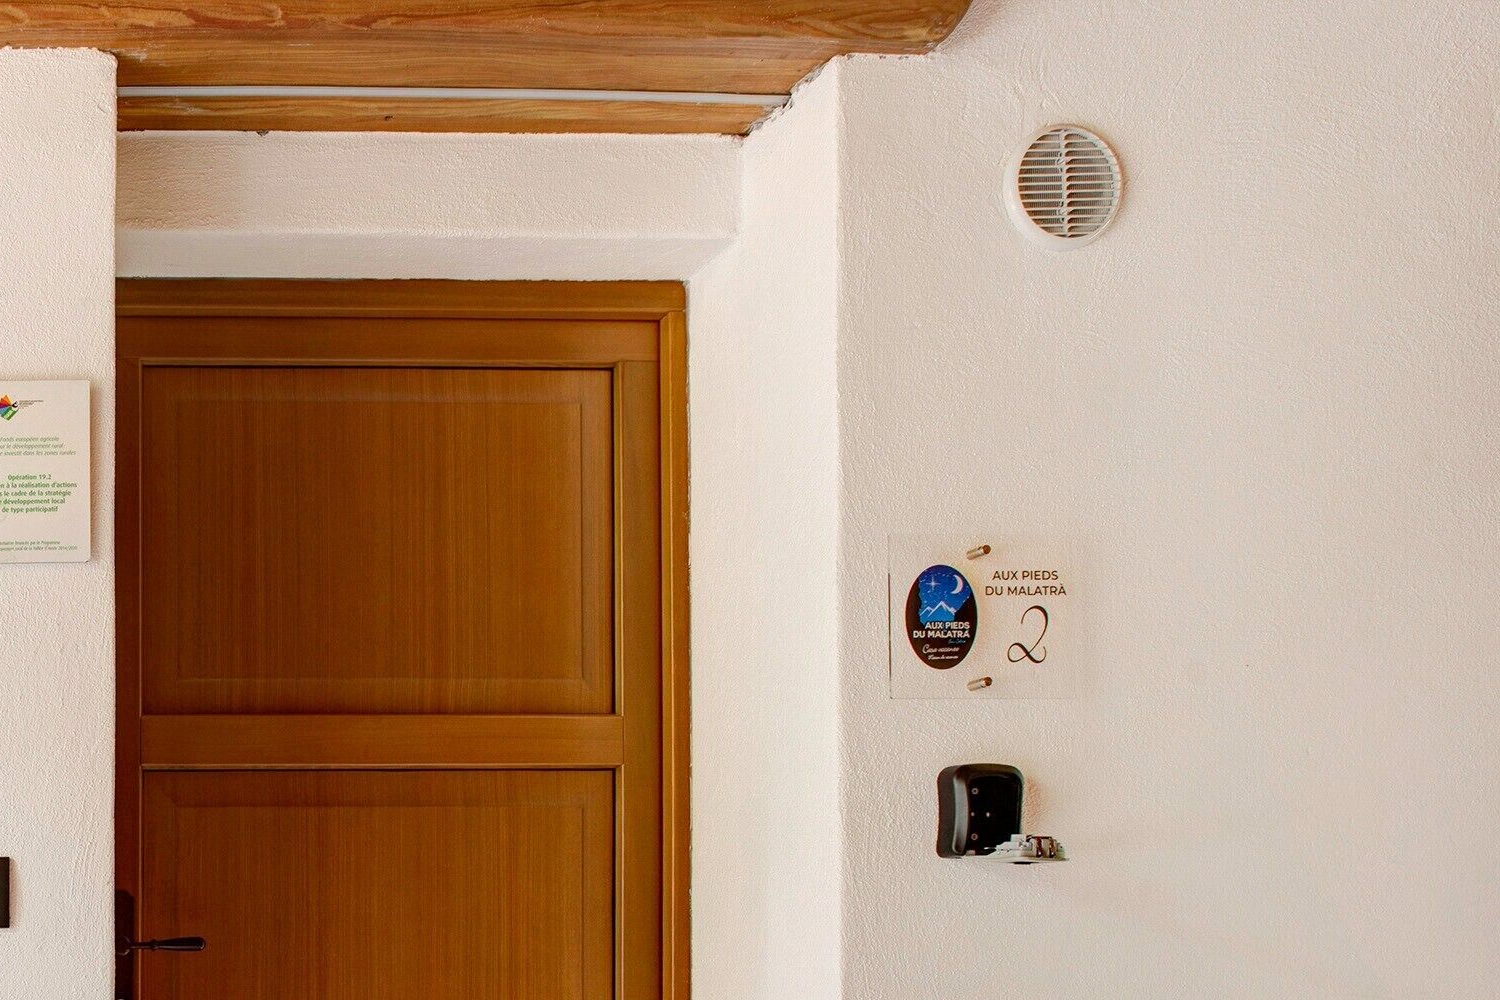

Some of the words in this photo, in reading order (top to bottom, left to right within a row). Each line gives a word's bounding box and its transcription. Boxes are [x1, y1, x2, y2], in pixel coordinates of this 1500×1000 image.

[992, 570, 1019, 581] AUX
[1022, 570, 1059, 581] PIEDS
[985, 586, 1004, 596] DU
[1007, 582, 1067, 596] MALATRÀ
[1007, 605, 1049, 664] 2
